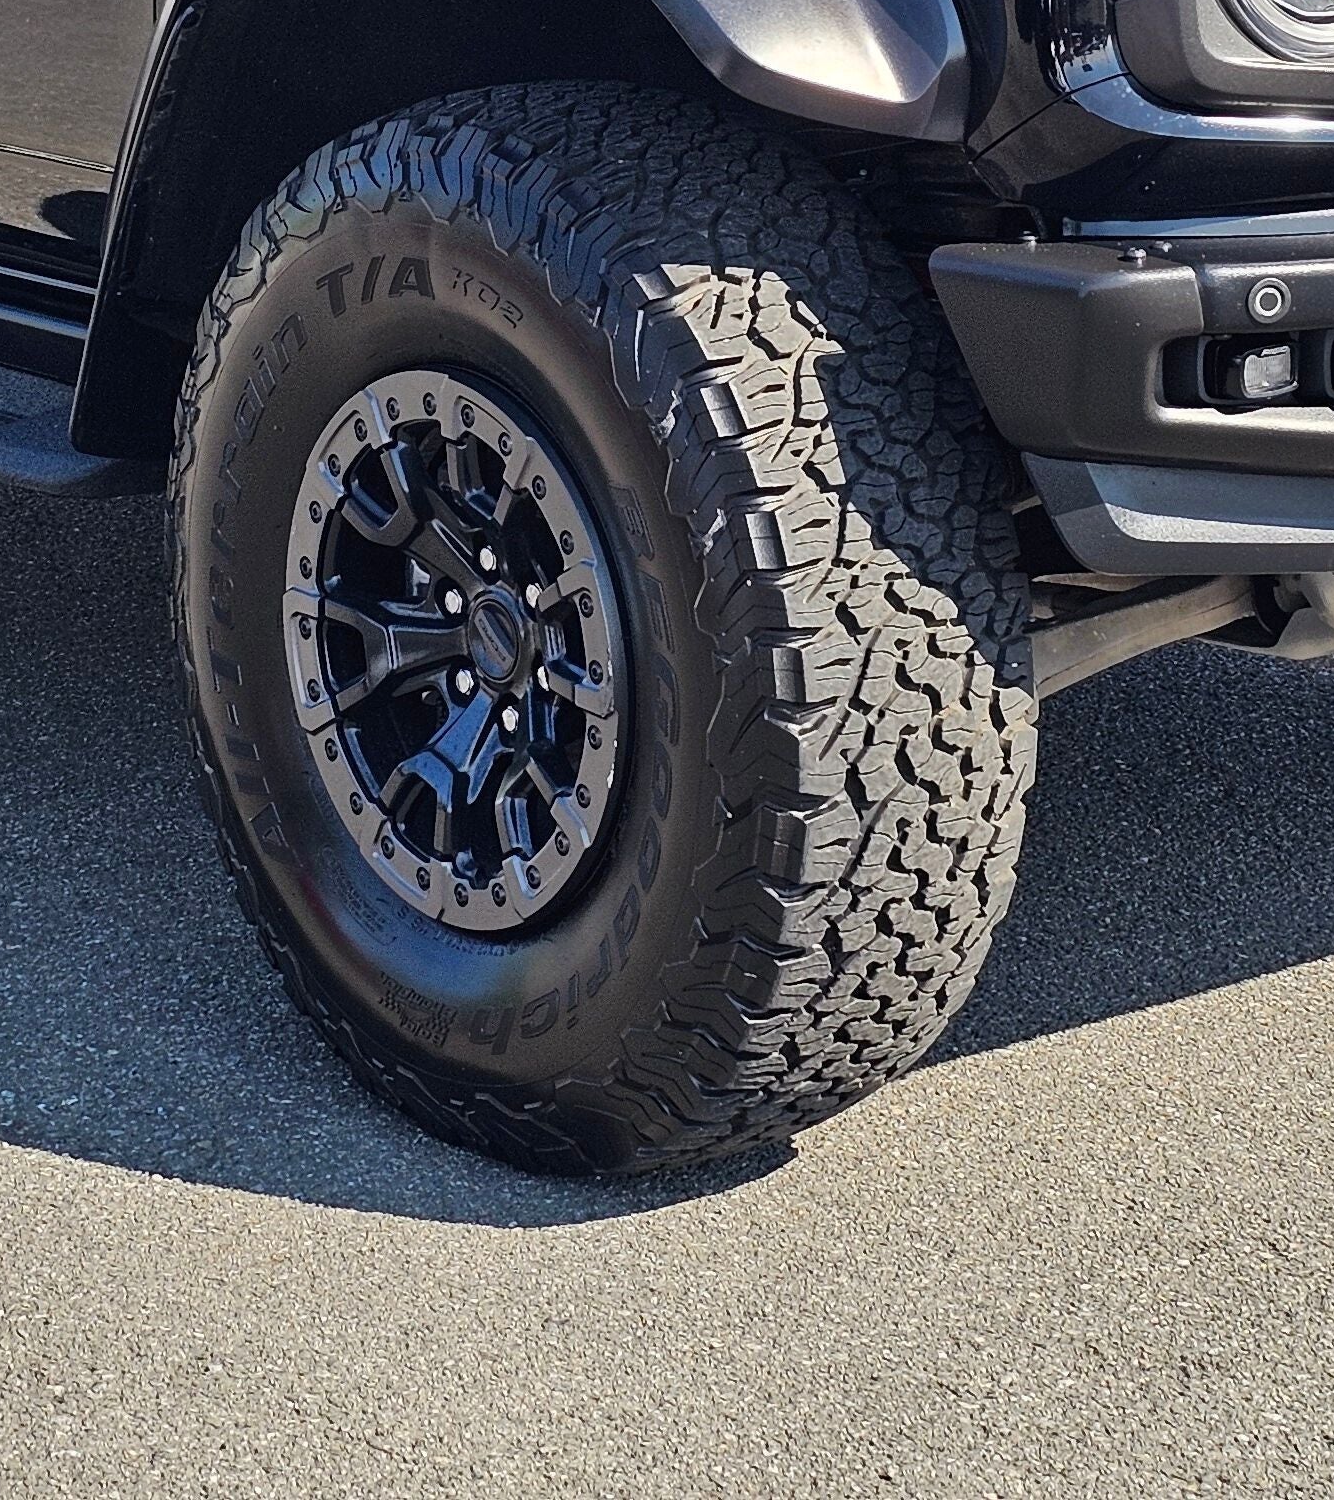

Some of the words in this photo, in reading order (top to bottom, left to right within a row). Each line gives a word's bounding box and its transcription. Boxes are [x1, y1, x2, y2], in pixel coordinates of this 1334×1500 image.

[316, 253, 435, 318] T/A
[451, 266, 524, 329] KO2
[467, 484, 681, 1056] BFGoodrich
